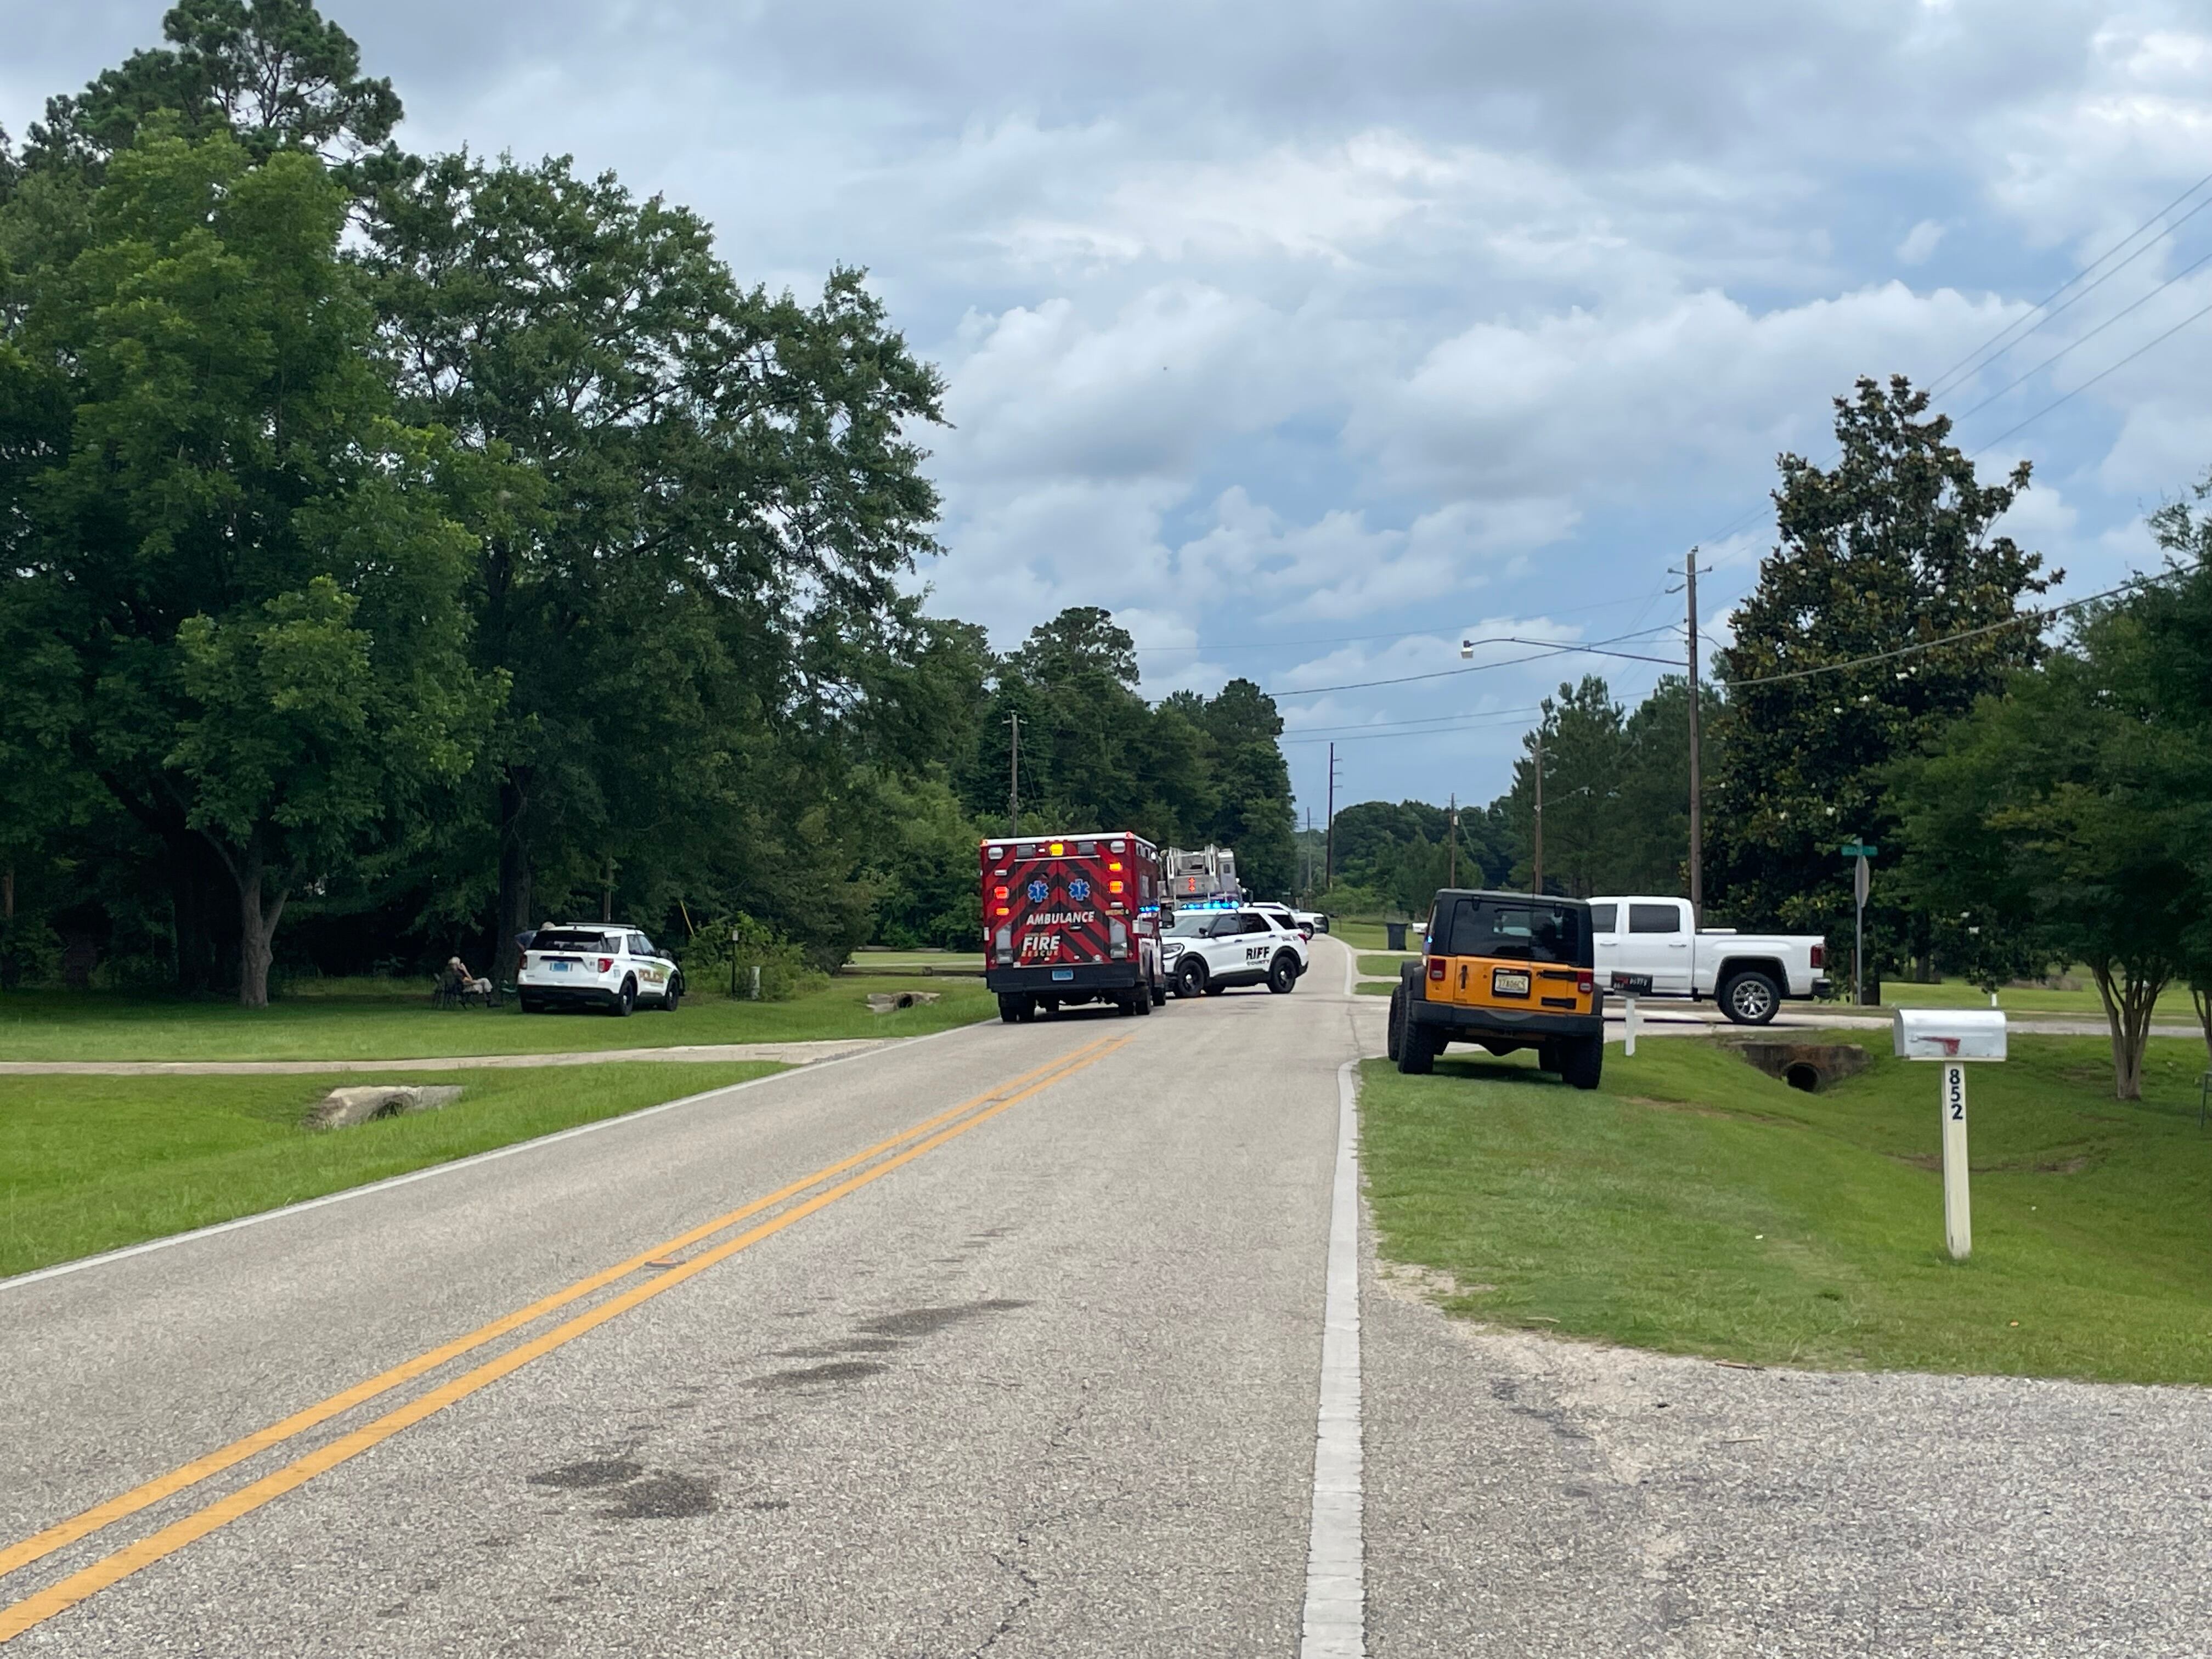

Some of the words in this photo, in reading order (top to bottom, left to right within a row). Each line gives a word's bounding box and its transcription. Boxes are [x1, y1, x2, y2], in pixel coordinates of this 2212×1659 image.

[1026, 911, 1095, 926] AMBULANCE
[1023, 935, 1060, 951] FIRE
[1246, 946, 1270, 960] RIFF
[1949, 1069, 1963, 1120] 852
